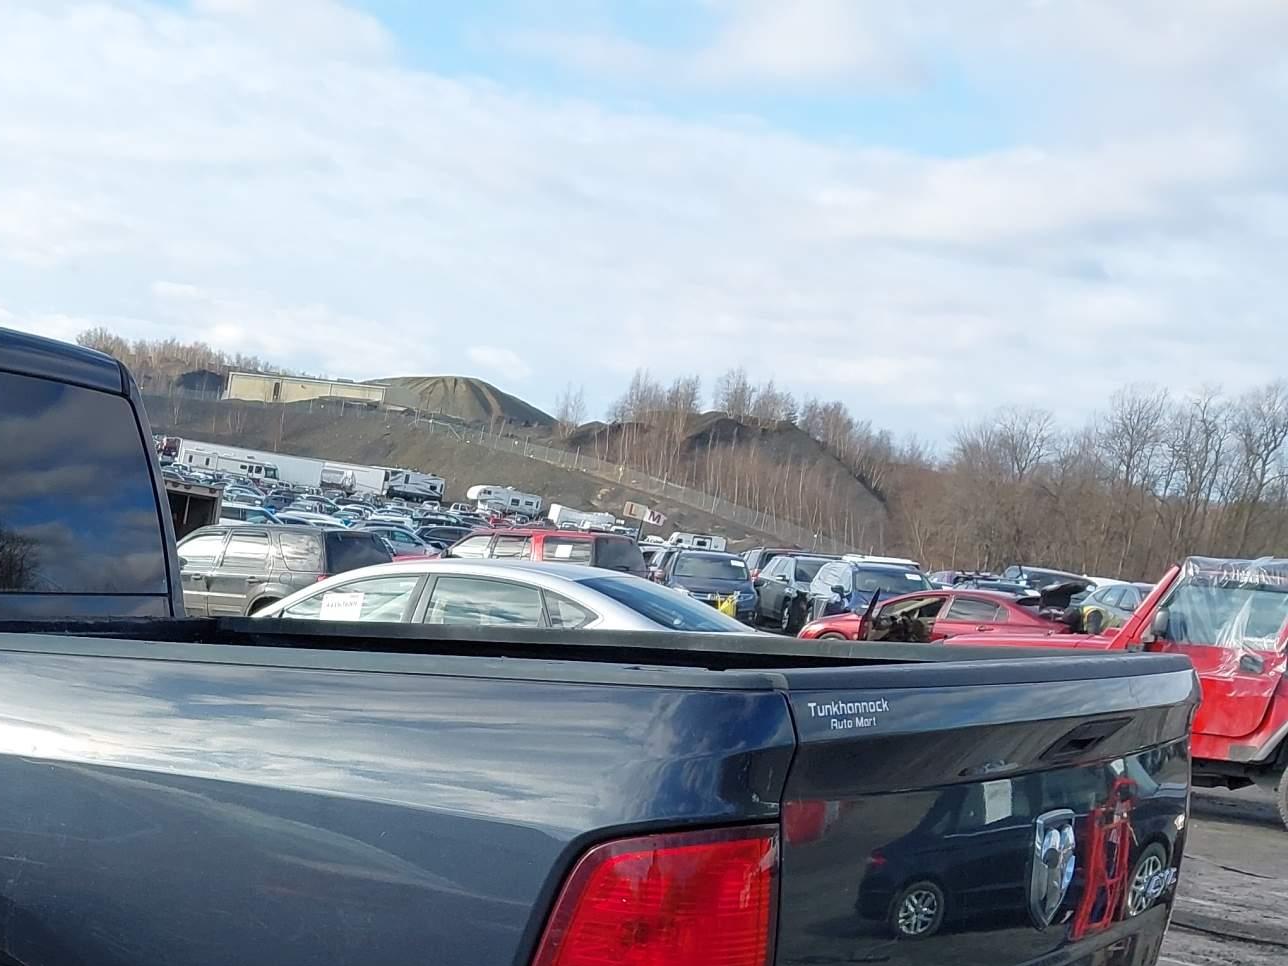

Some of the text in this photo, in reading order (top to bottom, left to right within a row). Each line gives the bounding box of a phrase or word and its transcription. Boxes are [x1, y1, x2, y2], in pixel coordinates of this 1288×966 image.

[648, 510, 662, 524] M
[808, 698, 890, 717] Tunkhannock
[830, 716, 877, 730] Auto Mart
